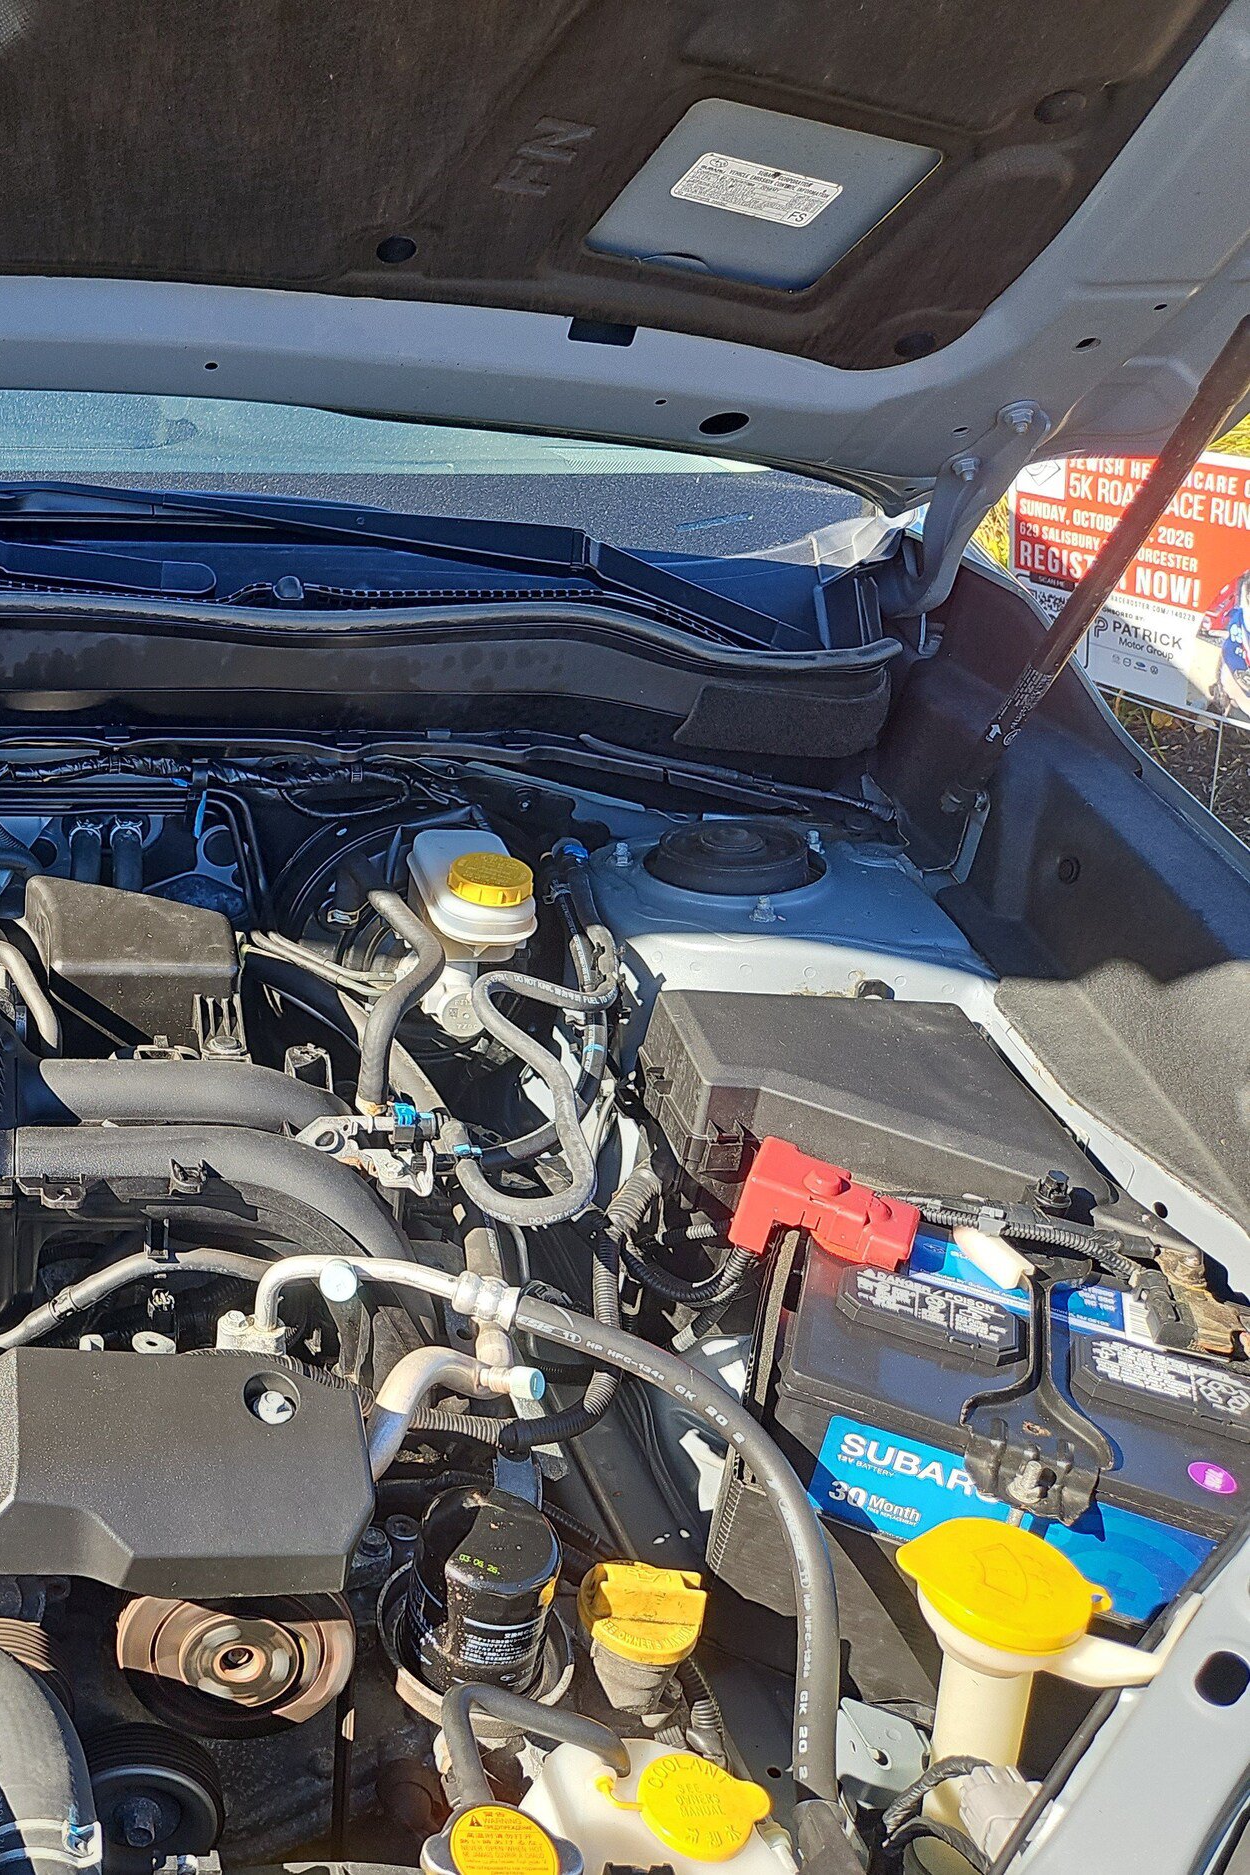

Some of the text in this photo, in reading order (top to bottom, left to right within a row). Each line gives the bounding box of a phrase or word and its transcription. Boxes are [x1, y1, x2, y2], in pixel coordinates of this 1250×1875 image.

[729, 169, 750, 180] VEHICLE
[750, 174, 774, 185] EMISSION
[798, 186, 830, 198] INFORMATION
[779, 176, 813, 188] CORPORATION
[787, 211, 808, 223] FS
[1069, 457, 1124, 476] JEWISH
[1069, 472, 1094, 501] 5K
[1097, 477, 1143, 508] ROA
[1163, 492, 1206, 522] ACE
[1019, 521, 1198, 573] 629 SALISBURY ORCESTER
[1157, 526, 1194, 549] 2026
[1135, 566, 1201, 608] NOW!
[1113, 620, 1183, 650] PATRICK
[1118, 637, 1174, 661] Motor Group
[528, 1216, 543, 1224] DO
[543, 1213, 563, 1223] NOT
[877, 1271, 931, 1295] DANGER
[945, 1291, 995, 1311] POISON
[585, 1340, 604, 1351] HP
[674, 1384, 697, 1402] GK
[704, 1405, 729, 1427] 20
[732, 1431, 746, 1444] 2
[837, 1454, 896, 1478] 12V BATTERY
[840, 1433, 1000, 1504] SUBAR
[828, 1479, 923, 1522] 30 Month
[866, 1506, 918, 1527] FREE REPLACEMENT
[803, 1593, 812, 1611] HP
[600, 1619, 618, 1634] SEE
[662, 1626, 694, 1648] MANUAL
[798, 1690, 809, 1715] GK
[798, 1725, 809, 1753] 20
[647, 1757, 736, 1789] COOLANT
[798, 1765, 809, 1780] 2
[675, 1793, 721, 1806] OWNERS
[678, 1784, 702, 1794] SEE
[679, 1805, 726, 1817] MANUAL
